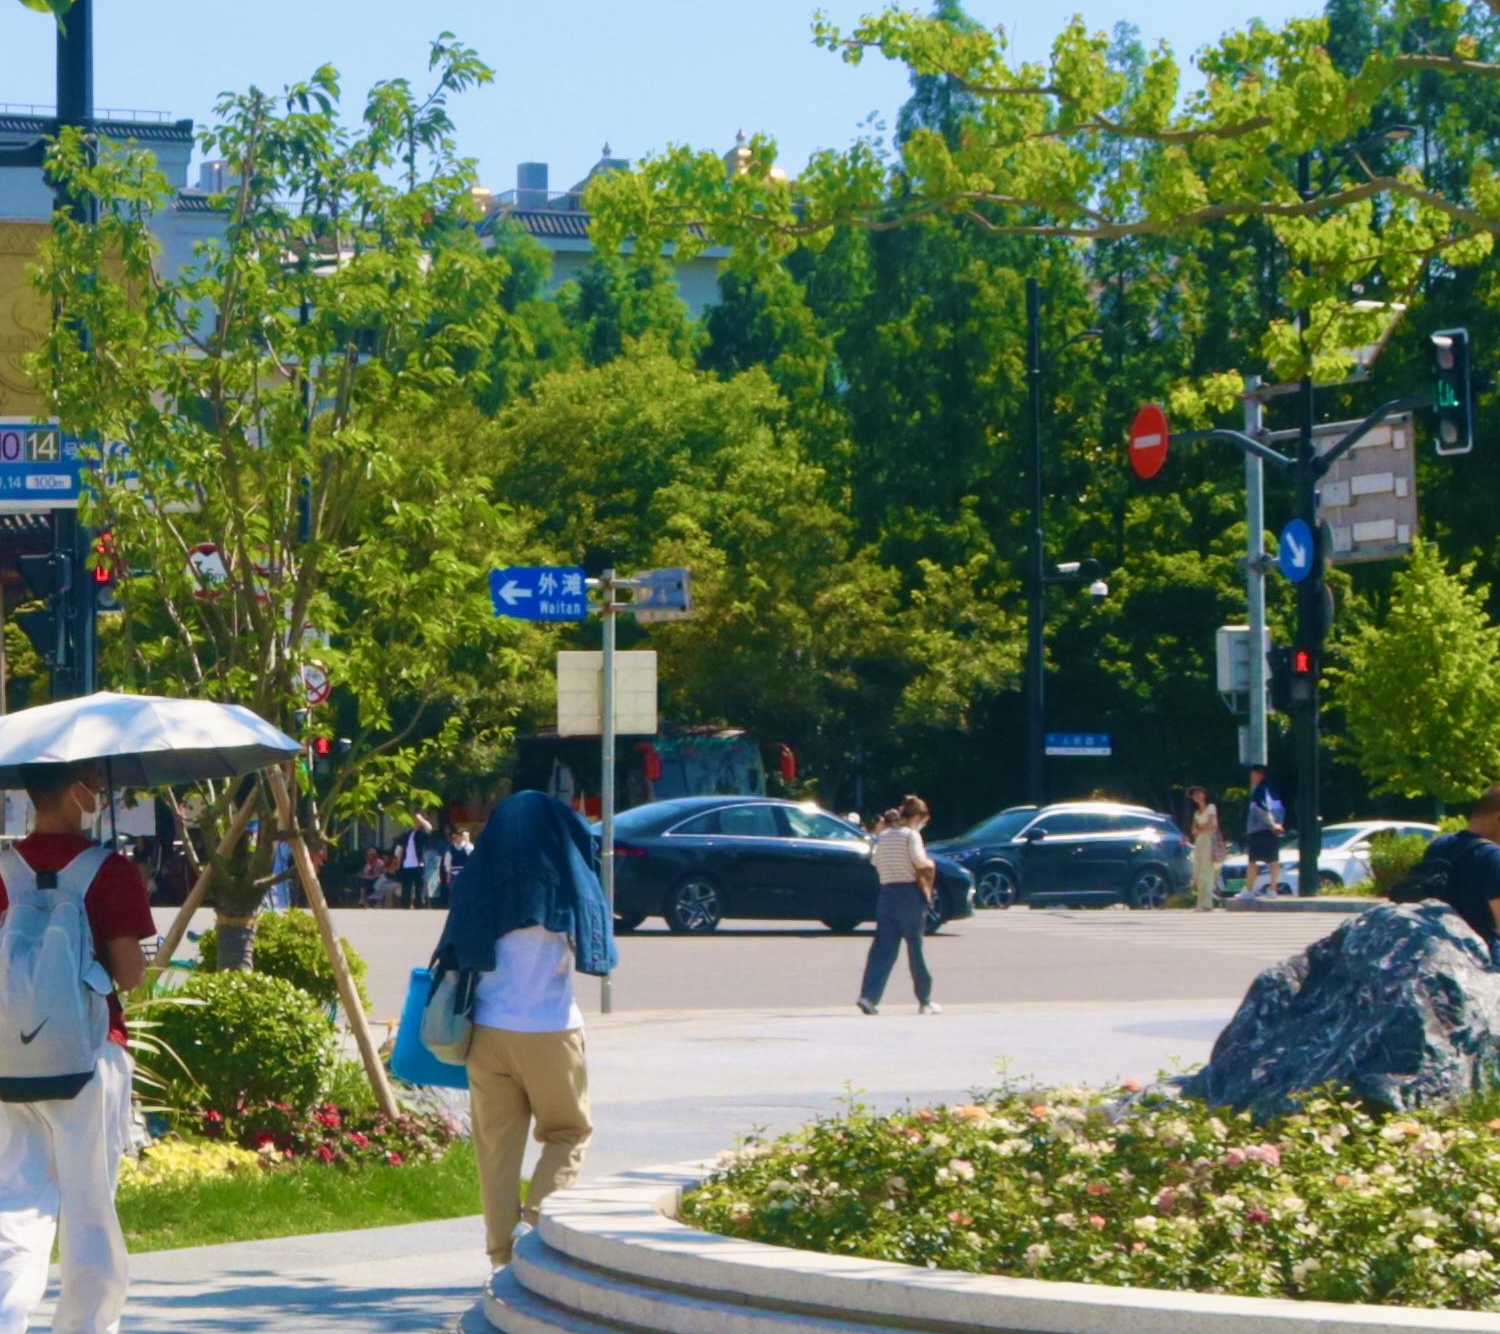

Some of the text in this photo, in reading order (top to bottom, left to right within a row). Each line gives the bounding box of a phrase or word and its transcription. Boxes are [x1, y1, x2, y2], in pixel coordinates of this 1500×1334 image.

[27, 432, 56, 461] 14
[538, 572, 582, 596] 外滩
[539, 600, 581, 614] Waitan
